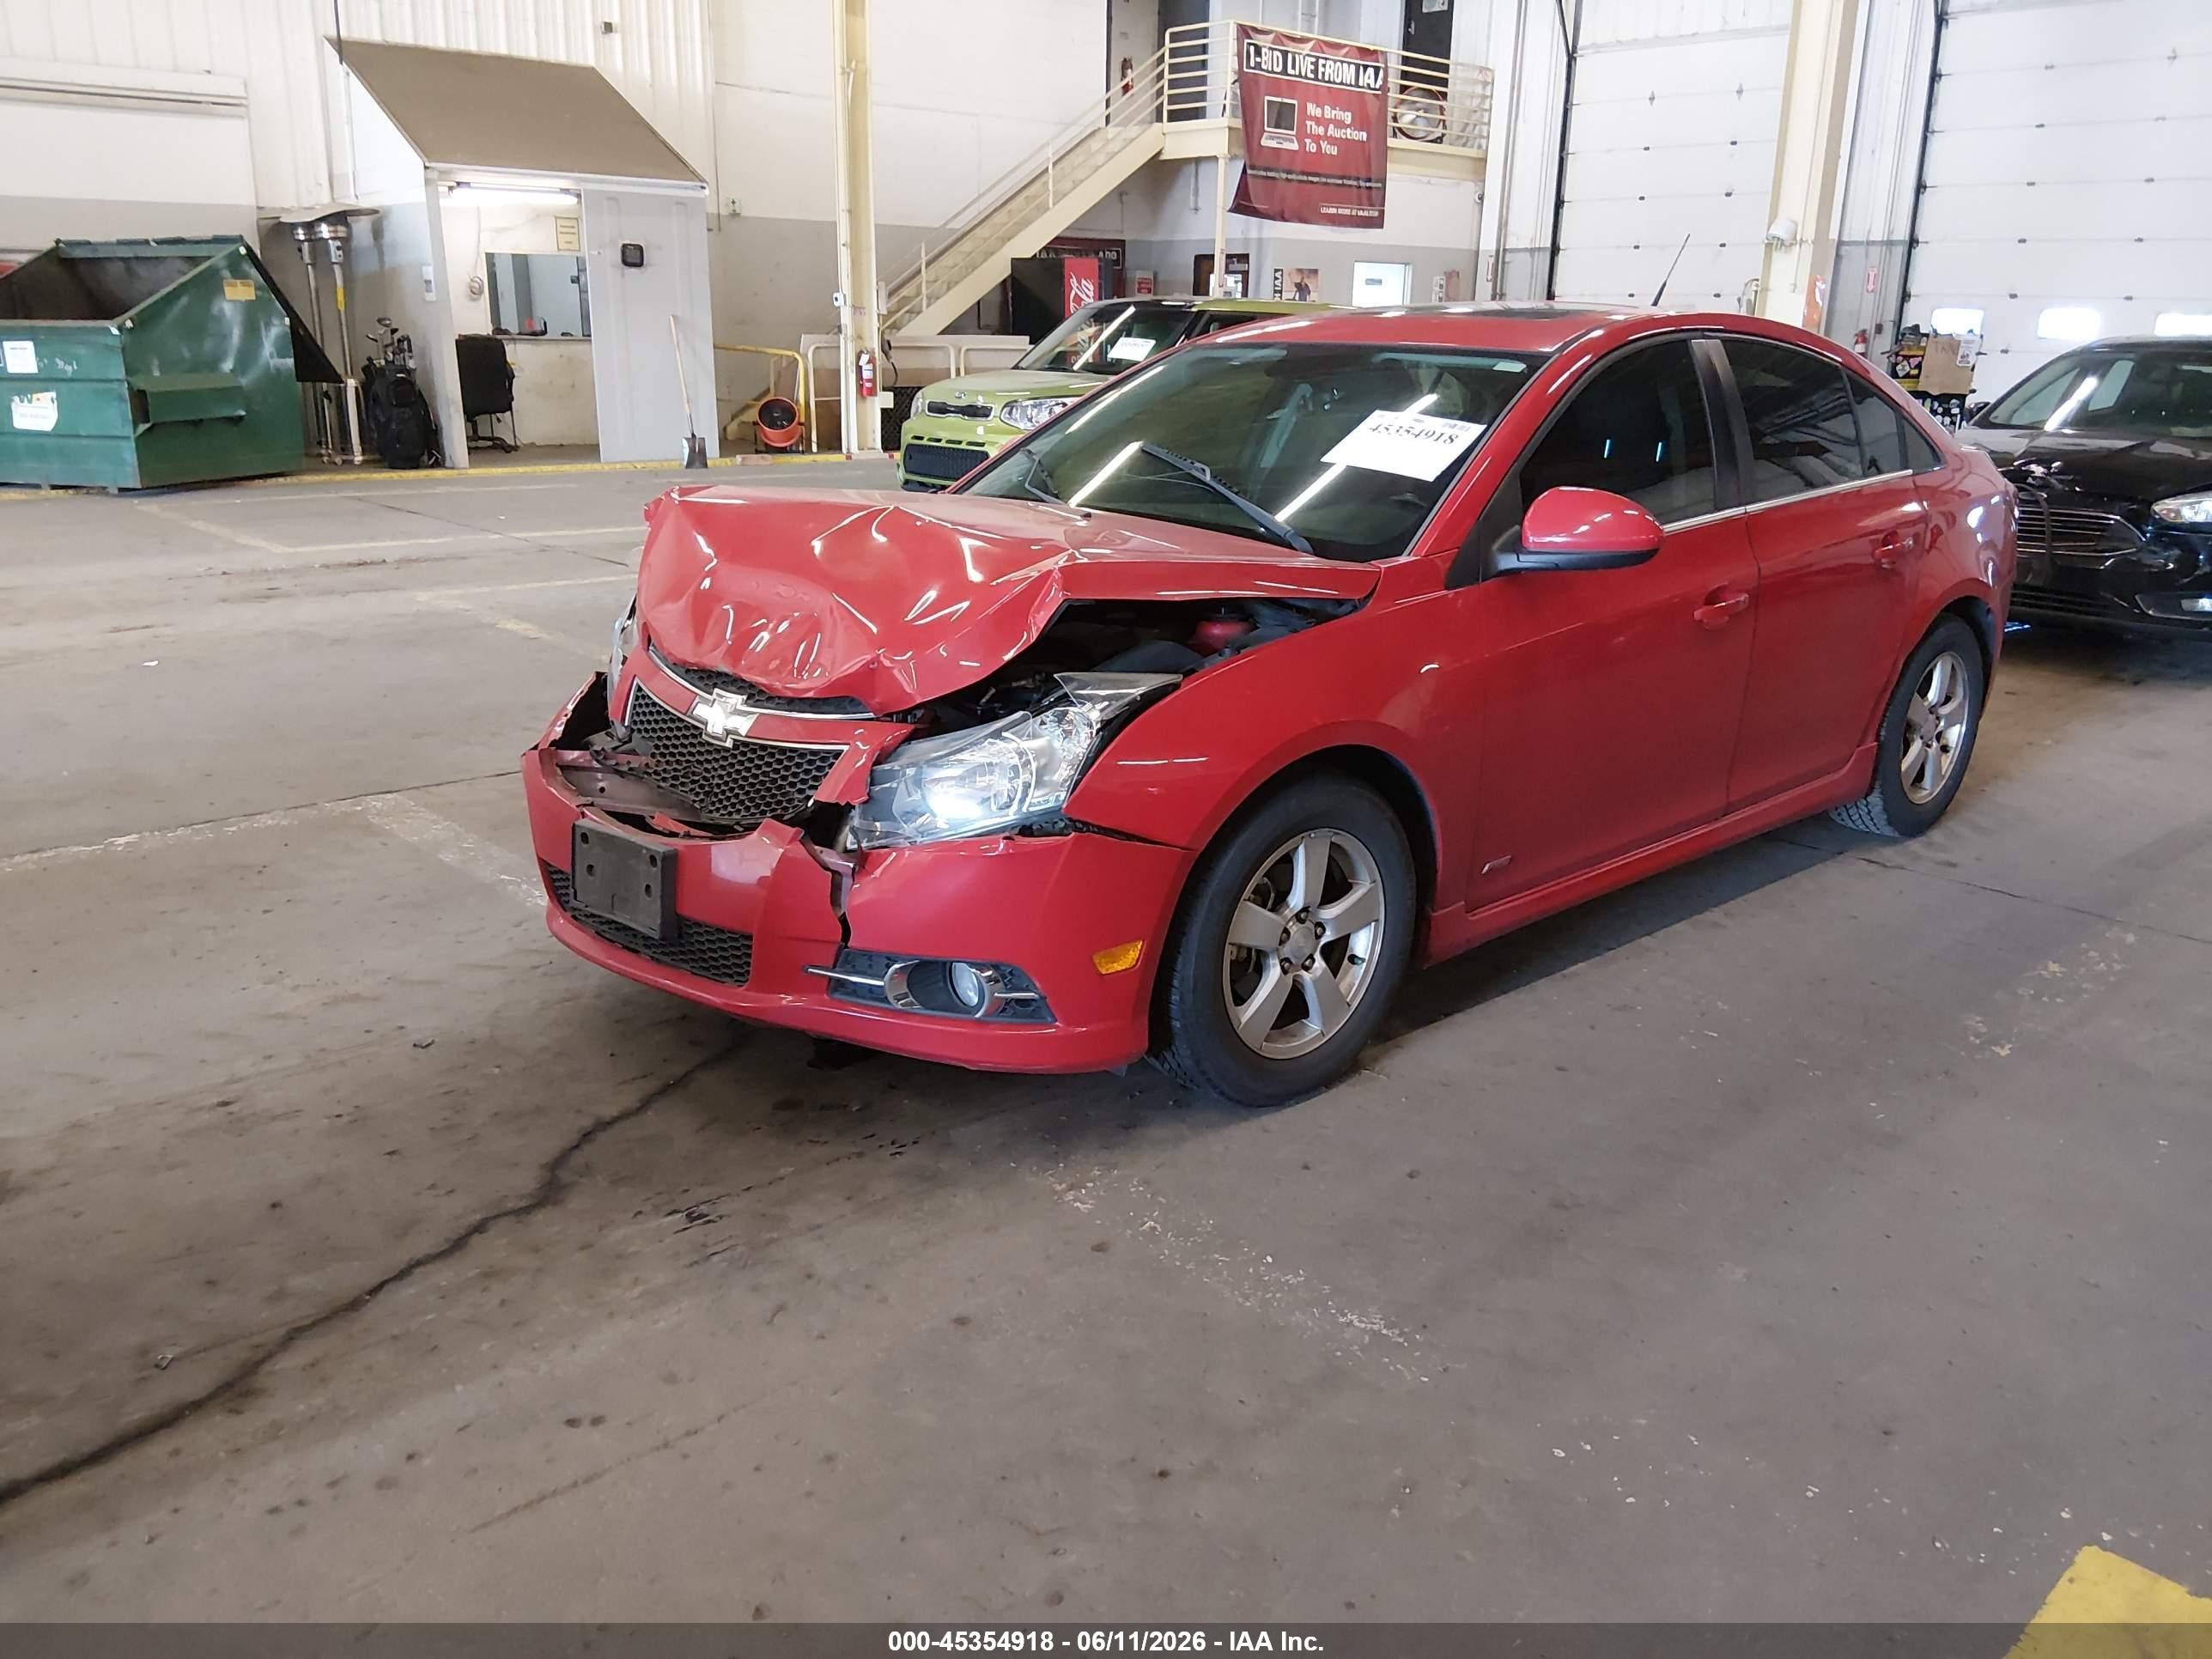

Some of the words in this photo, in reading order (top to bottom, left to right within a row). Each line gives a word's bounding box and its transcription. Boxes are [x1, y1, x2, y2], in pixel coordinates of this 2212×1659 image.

[1249, 45, 1283, 73] I-BID
[1287, 52, 1316, 78] LIVE
[1318, 58, 1356, 85] FROM
[1306, 102, 1322, 116] We
[1323, 105, 1352, 124] Bring
[1305, 120, 1325, 137] The
[1327, 123, 1368, 142] Auction
[1304, 138, 1317, 153] To
[1319, 140, 1338, 155] You
[1368, 422, 1459, 445] 45354918
